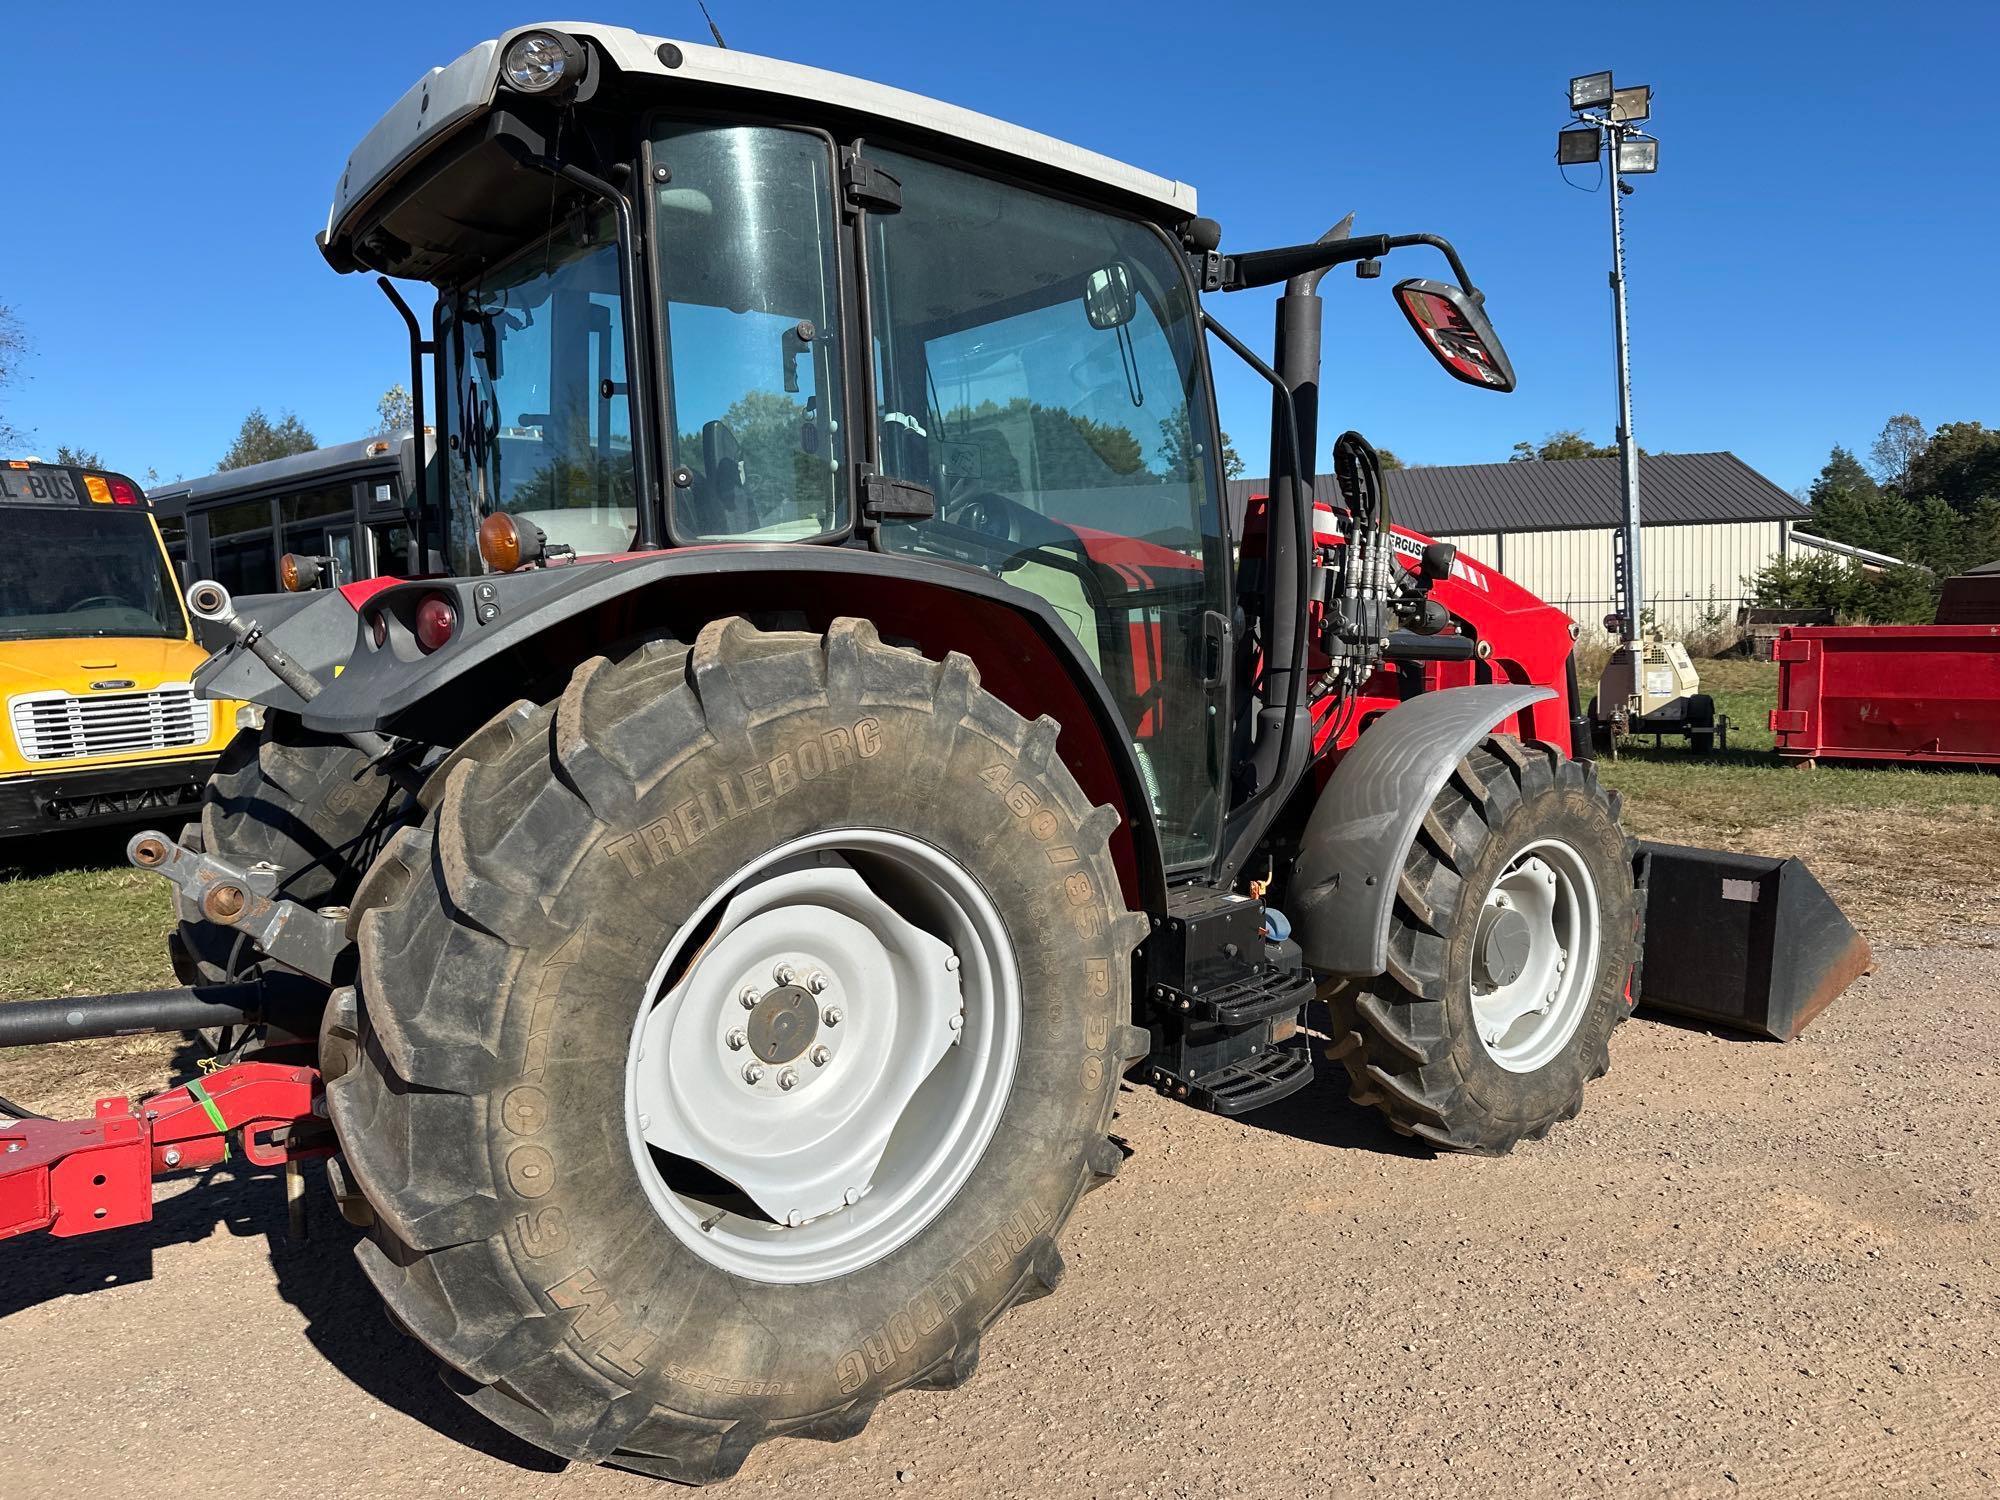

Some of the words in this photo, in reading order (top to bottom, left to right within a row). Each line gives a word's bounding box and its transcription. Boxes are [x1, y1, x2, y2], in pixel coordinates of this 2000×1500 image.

[0, 474, 17, 497] L
[27, 476, 76, 499] BUS
[603, 717, 883, 880] TRELLEBORG
[834, 1198, 1055, 1396] TRELLEBORG
[661, 1360, 796, 1397] TUBELESS
